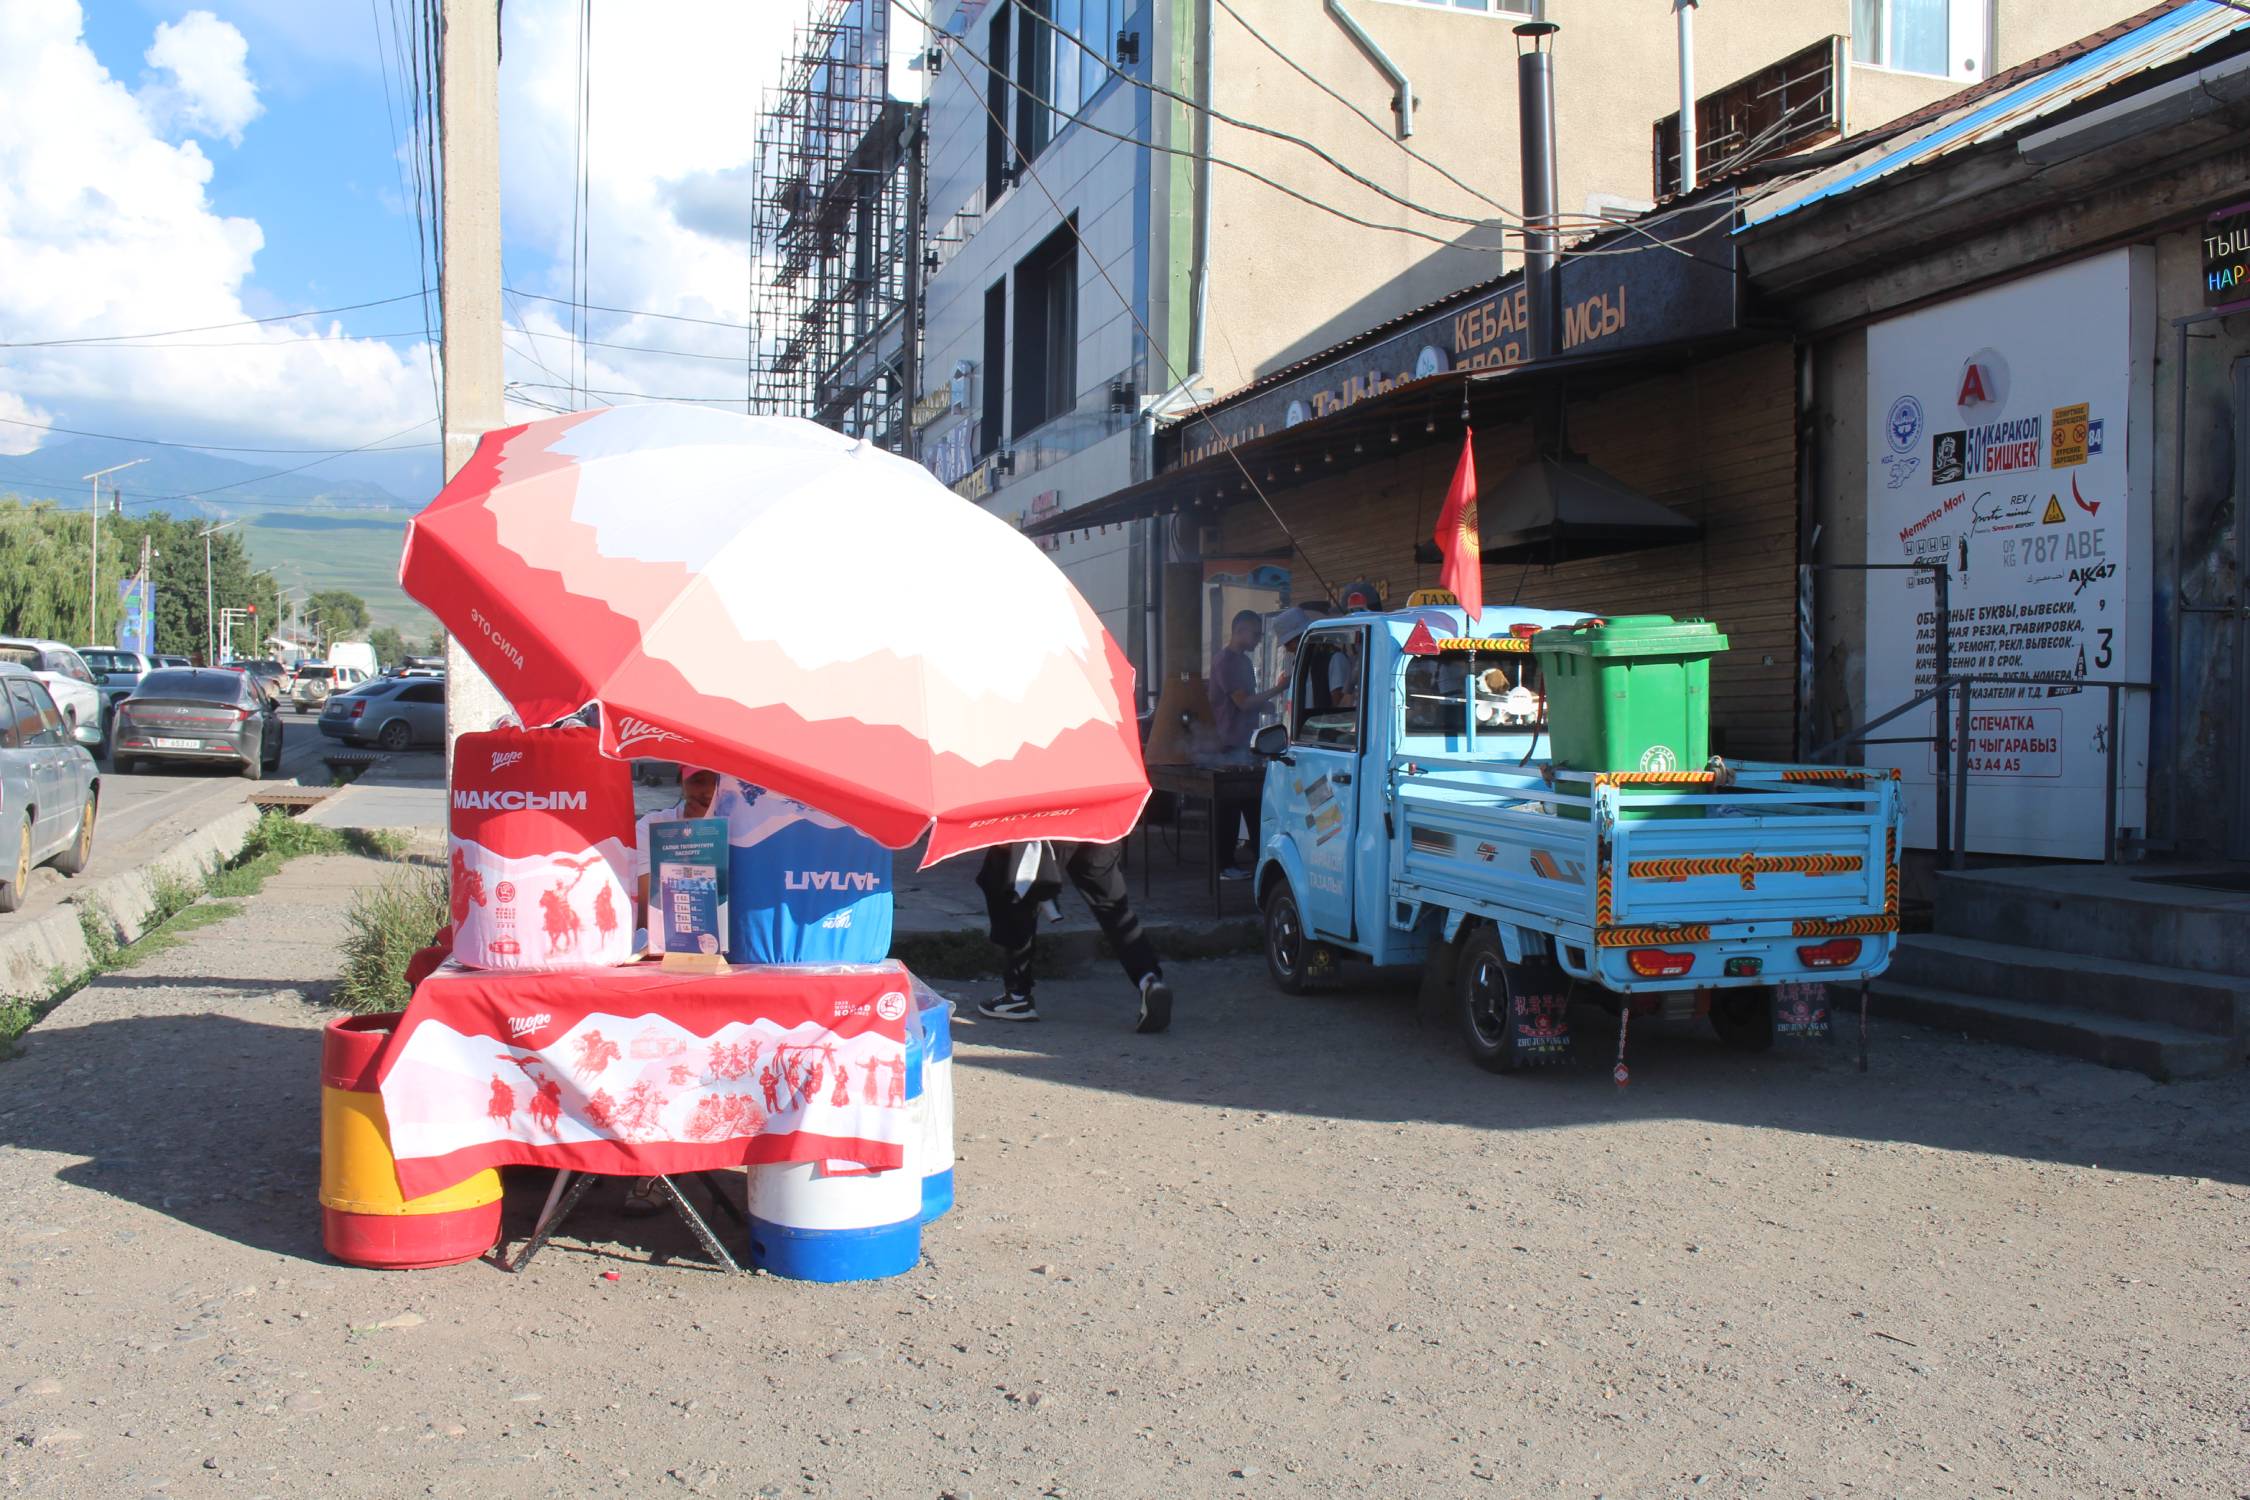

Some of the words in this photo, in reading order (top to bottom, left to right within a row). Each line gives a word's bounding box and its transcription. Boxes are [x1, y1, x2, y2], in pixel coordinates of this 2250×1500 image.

[1562, 285, 1626, 350] МСЫ
[1987, 416, 2039, 446] КАРАКОЛ
[2088, 428, 2101, 447] 84
[1986, 441, 2038, 473] БИШКЕК
[2010, 494, 2028, 505] REX
[1900, 509, 1943, 542] Memento
[1943, 492, 1966, 513] Mori
[2021, 534, 2060, 565] 787
[1917, 607, 1976, 626] ОБЪНЫЕ
[2010, 620, 2085, 635] ГРАВИРОВКА,
[471, 608, 491, 636] ЭТО
[491, 631, 524, 671] СИЛА
[1958, 640, 1997, 653] РЕМОНТ,
[2026, 636, 2074, 650] ВЫВЕСОК.
[2095, 628, 2112, 669] 3
[1916, 656, 1976, 669] КАЧЕВЕННО
[1979, 656, 1986, 667] И
[1988, 656, 1995, 667] В
[1997, 655, 2023, 667] СРОК.
[2018, 687, 2025, 698] И
[1955, 715, 2035, 731] РСПЕЧАТКА
[1980, 737, 2057, 753] ЧЫГАРАБЫЗ
[454, 790, 588, 810] МАКСЫМ
[508, 1014, 552, 1039] Шоро
